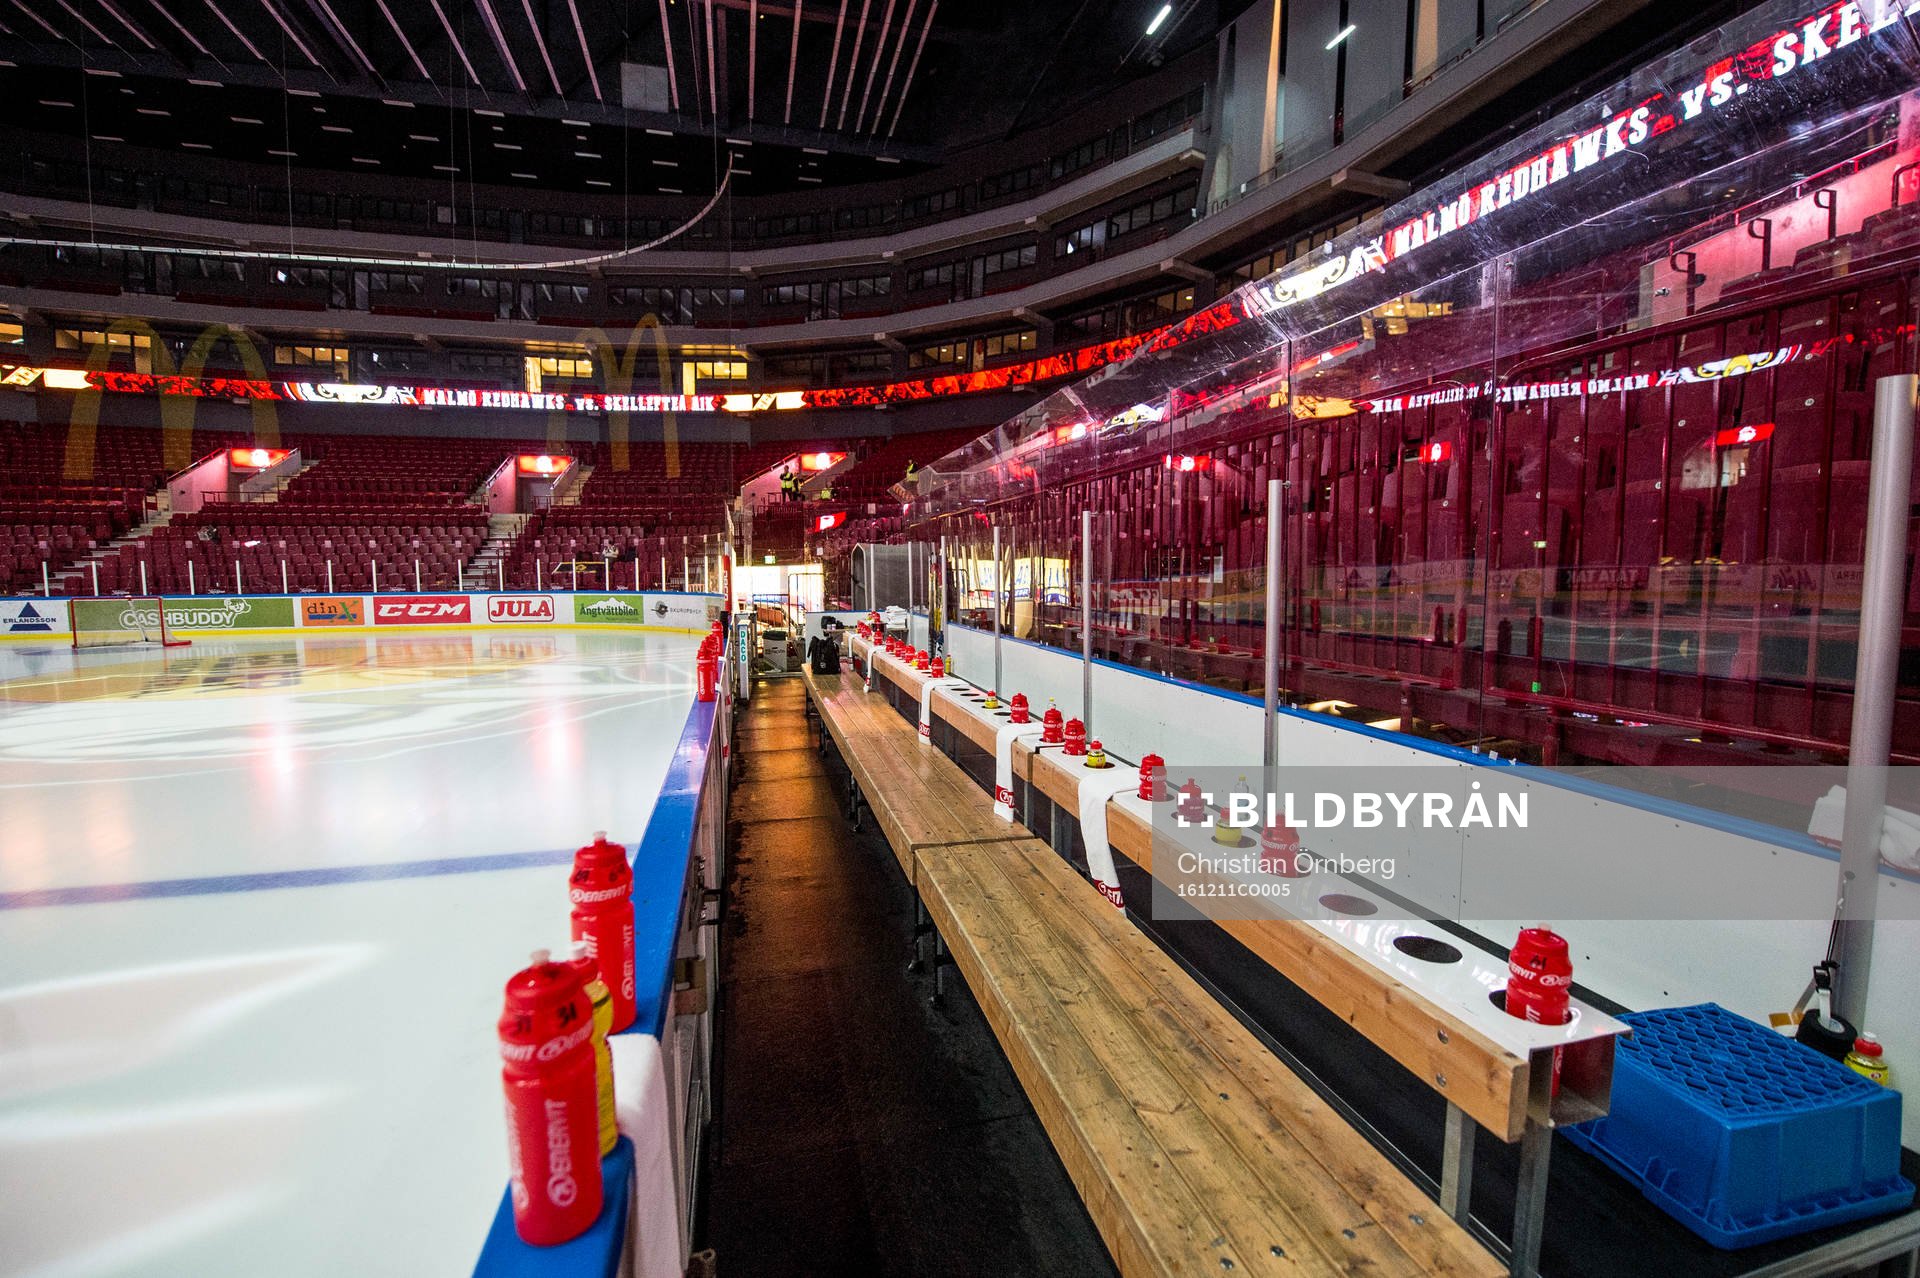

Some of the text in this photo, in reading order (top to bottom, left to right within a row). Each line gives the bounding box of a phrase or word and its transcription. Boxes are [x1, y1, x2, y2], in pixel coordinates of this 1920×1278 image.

[1394, 191, 1471, 257] MALMÖ
[1479, 107, 1650, 215] REDHAWKS
[481, 391, 565, 411] REDHAWKS
[378, 603, 467, 617] CCM
[490, 600, 553, 618] JULA
[122, 611, 234, 627] CASHBUDDY
